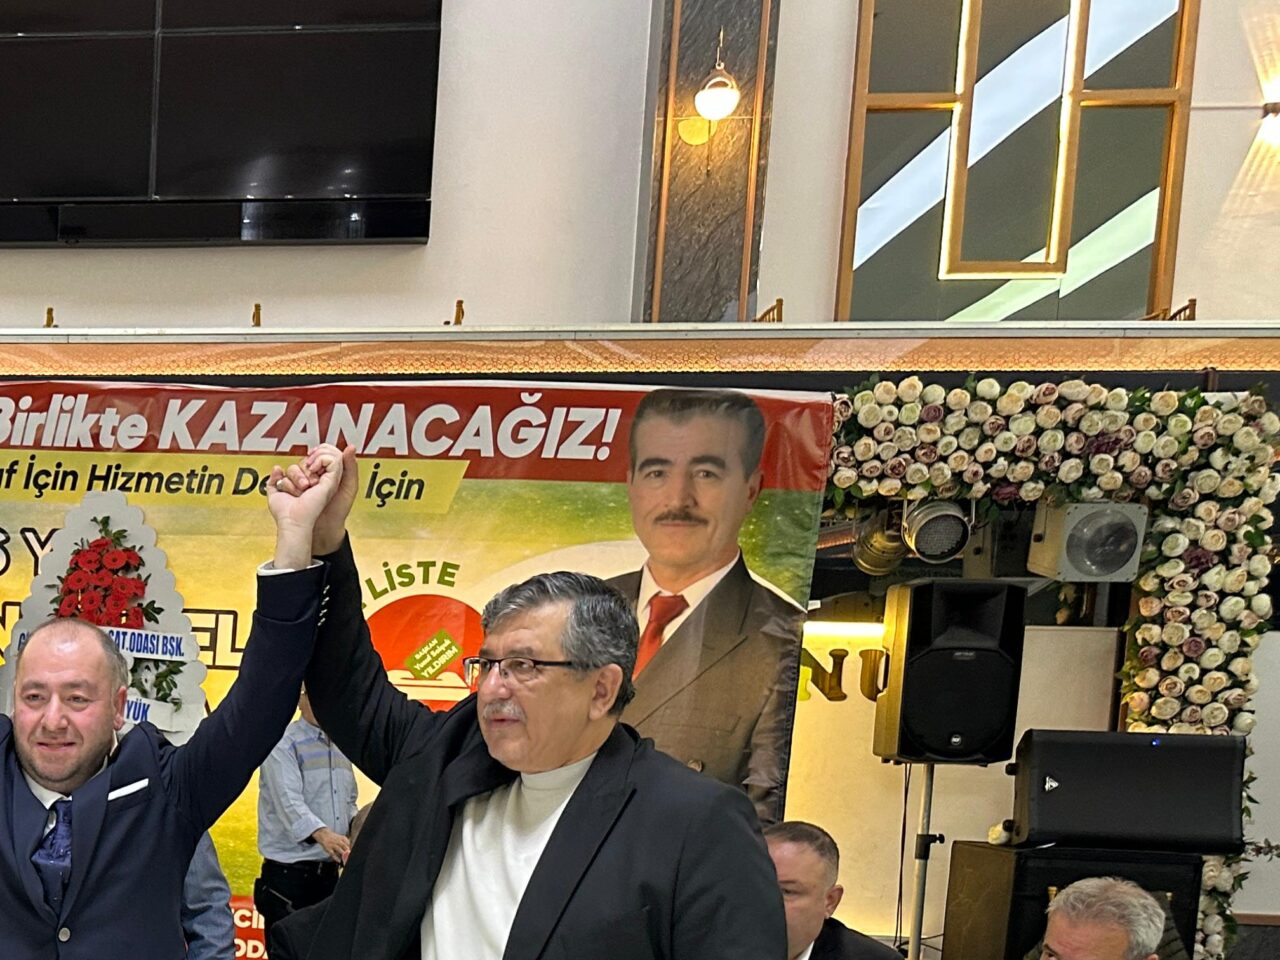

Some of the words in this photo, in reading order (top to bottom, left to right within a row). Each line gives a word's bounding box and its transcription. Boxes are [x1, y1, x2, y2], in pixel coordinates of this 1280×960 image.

[157, 392, 622, 461] KAZANACAĞIZ!
[23, 454, 79, 498] İçin
[87, 463, 224, 494] Hizmetin
[232, 467, 269, 496] De
[365, 462, 425, 508] İçin
[365, 561, 460, 600] LİSTE
